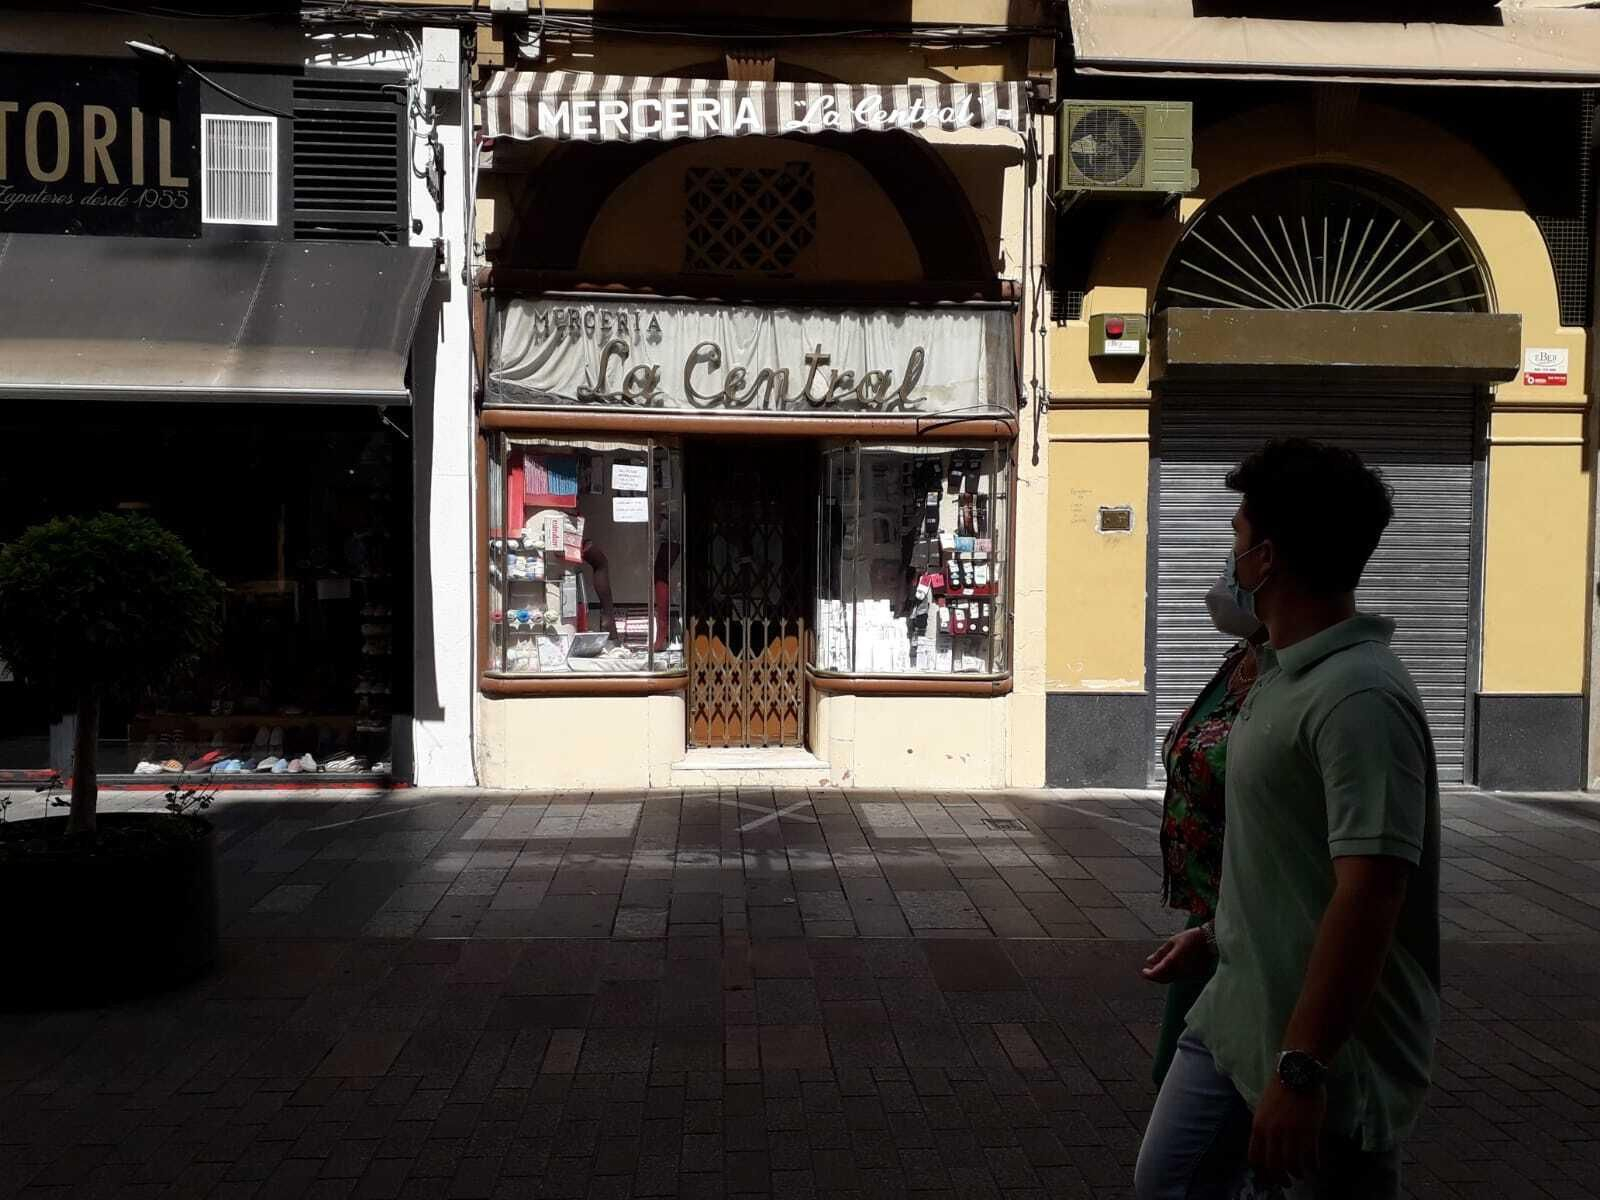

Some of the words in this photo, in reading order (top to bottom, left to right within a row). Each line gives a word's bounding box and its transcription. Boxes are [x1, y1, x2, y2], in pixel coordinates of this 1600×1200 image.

[538, 96, 762, 136] MERCERIA
[80, 186, 130, 208] desde
[135, 188, 190, 209] 1955
[535, 308, 662, 333] MERCERIA
[577, 339, 664, 406] La
[684, 341, 927, 410] Central
